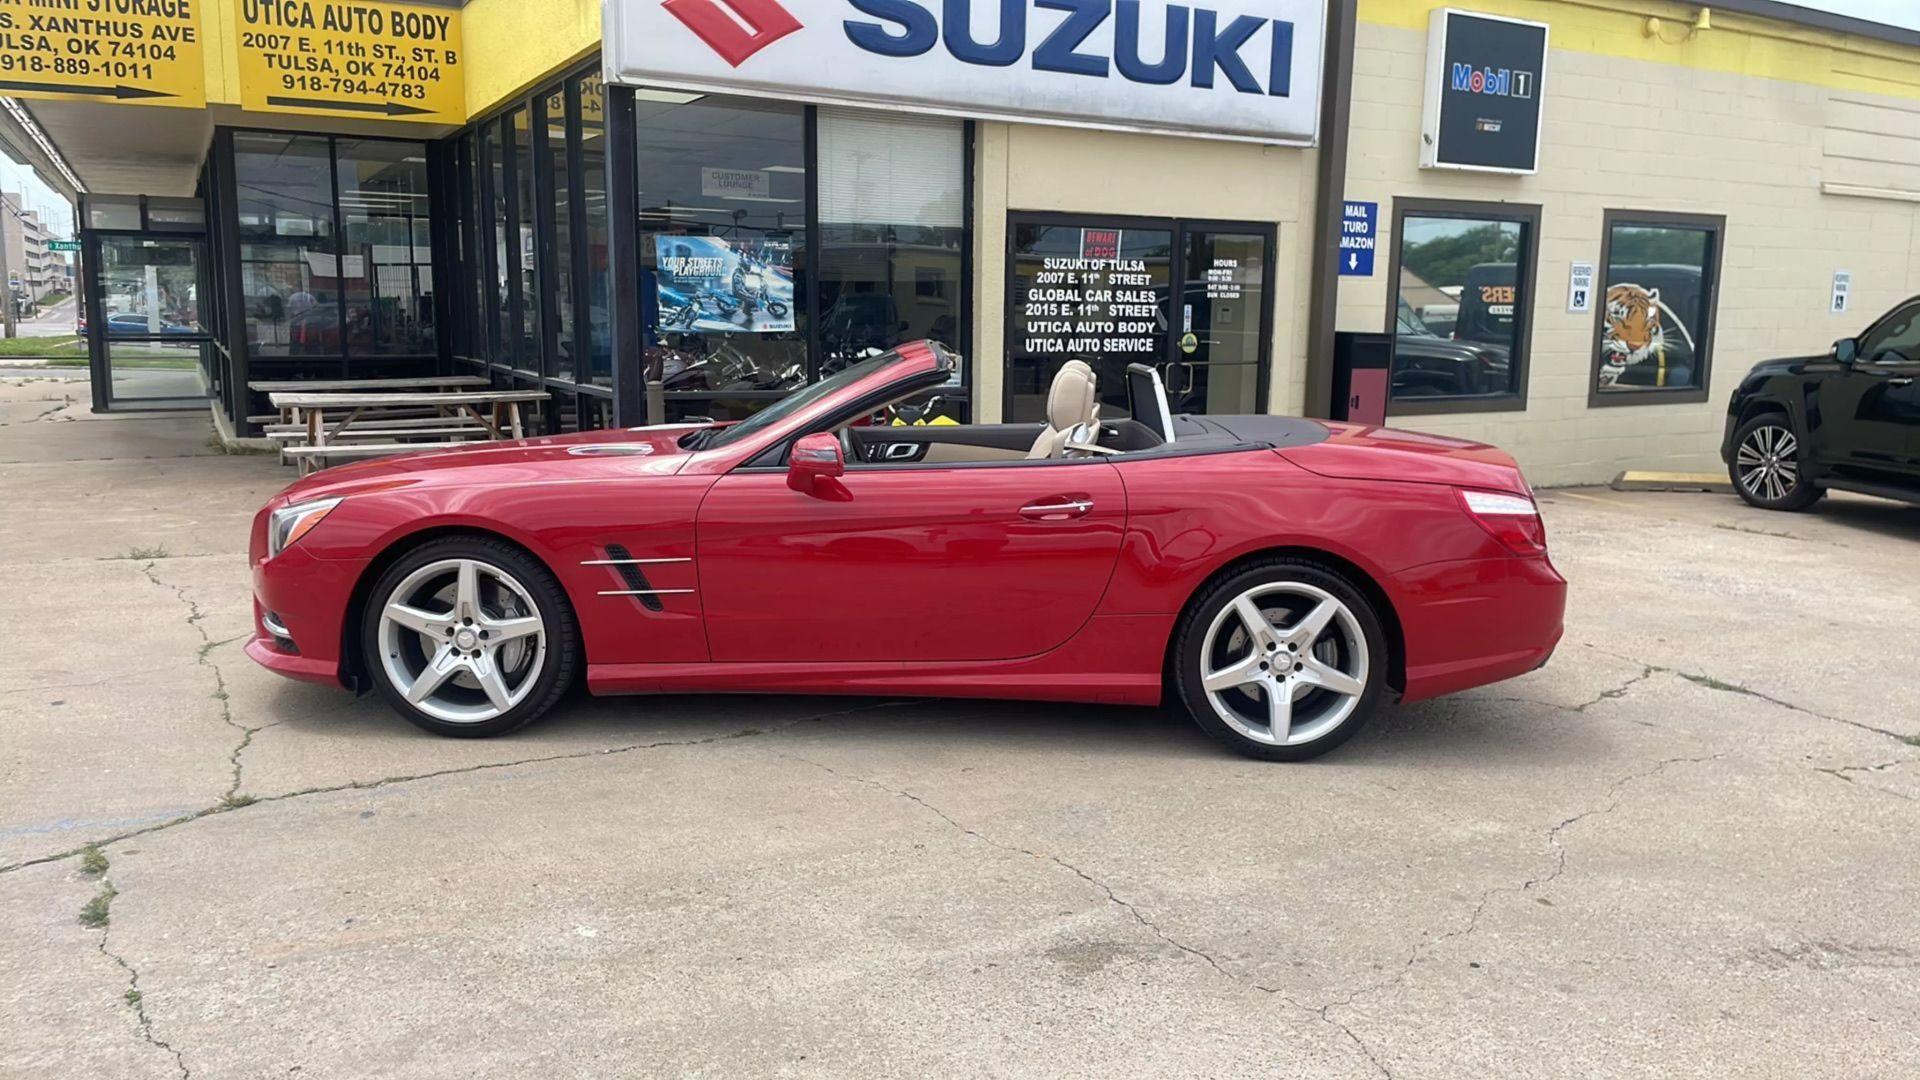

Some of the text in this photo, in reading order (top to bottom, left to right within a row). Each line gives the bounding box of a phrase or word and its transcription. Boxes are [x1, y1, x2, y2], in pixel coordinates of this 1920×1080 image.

[243, 0, 449, 41] UTICA AUTO BODY
[28, 14, 144, 39] XANTHUS
[151, 25, 196, 43] AVE
[66, 38, 101, 56] OK
[108, 41, 176, 61] 74104
[242, 32, 457, 65] 2007 E. 11th ST., ST. B
[843, 0, 1294, 97] SUZUKI
[1, 54, 153, 80] 918-889-1011
[263, 53, 440, 82] TULSA, OK 74104
[282, 74, 426, 99] 918-794-4783
[1452, 63, 1510, 96] Mobil
[711, 171, 760, 183] CUSTOMER
[1345, 205, 1368, 218] MAIL
[1343, 221, 1368, 234] TURO
[1086, 231, 1117, 243] BEWARE
[1094, 247, 1116, 257] DOG
[662, 257, 686, 268] YOUR
[1043, 257, 1146, 272] SUZUKI OF TULSA
[1213, 259, 1238, 268] HOURS
[1037, 272, 1151, 286] 2007 E. 11th STREET
[1028, 288, 1156, 303] GLOBAL CAR SALES
[1025, 303, 1158, 317] 2015 E. 11th STREET
[1027, 321, 1156, 334] UTICA AUTO BODY
[1025, 338, 1154, 352] UTICA AUTO SERVICE
